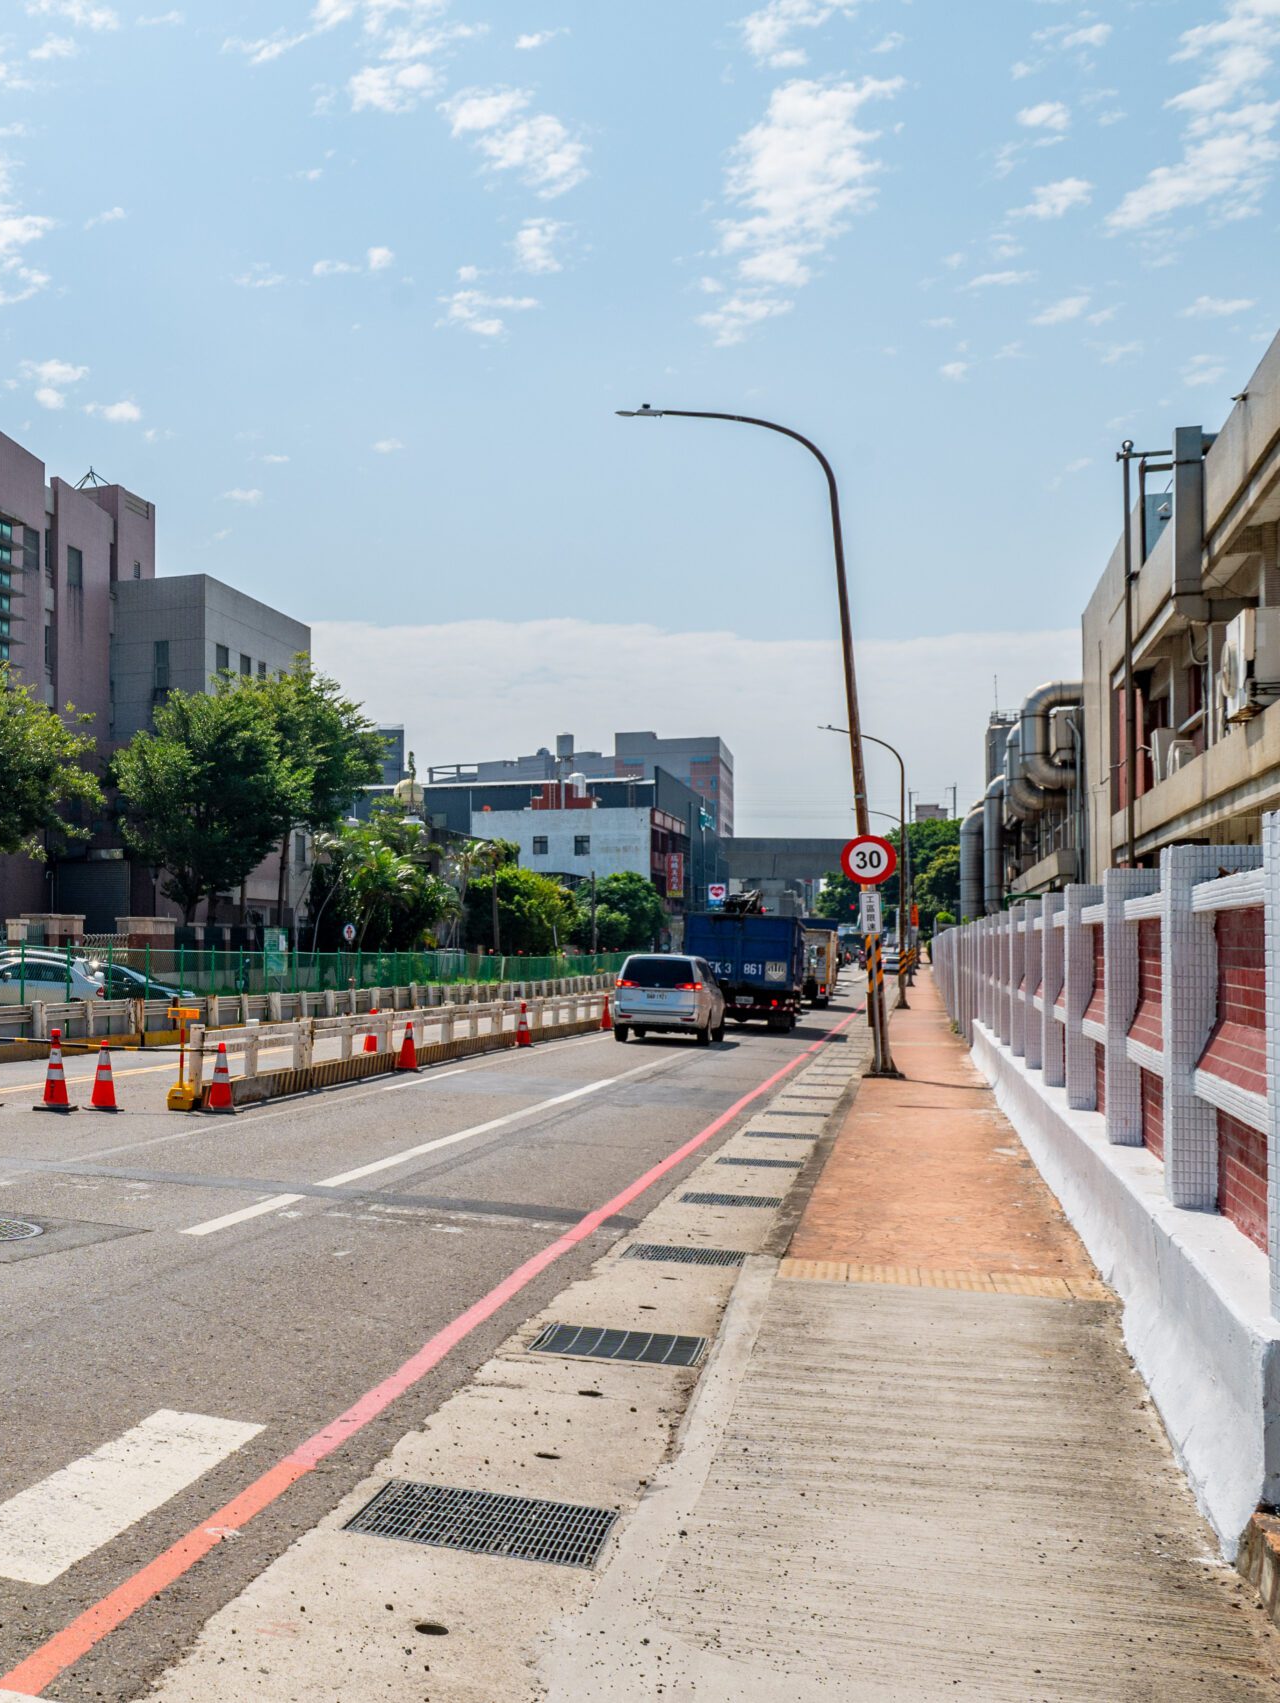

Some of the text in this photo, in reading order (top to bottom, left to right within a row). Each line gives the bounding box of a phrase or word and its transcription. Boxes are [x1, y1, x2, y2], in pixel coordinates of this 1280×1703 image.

[855, 850, 881, 869] 30
[866, 896, 876, 931] 工區限速
[743, 963, 762, 975] 861
